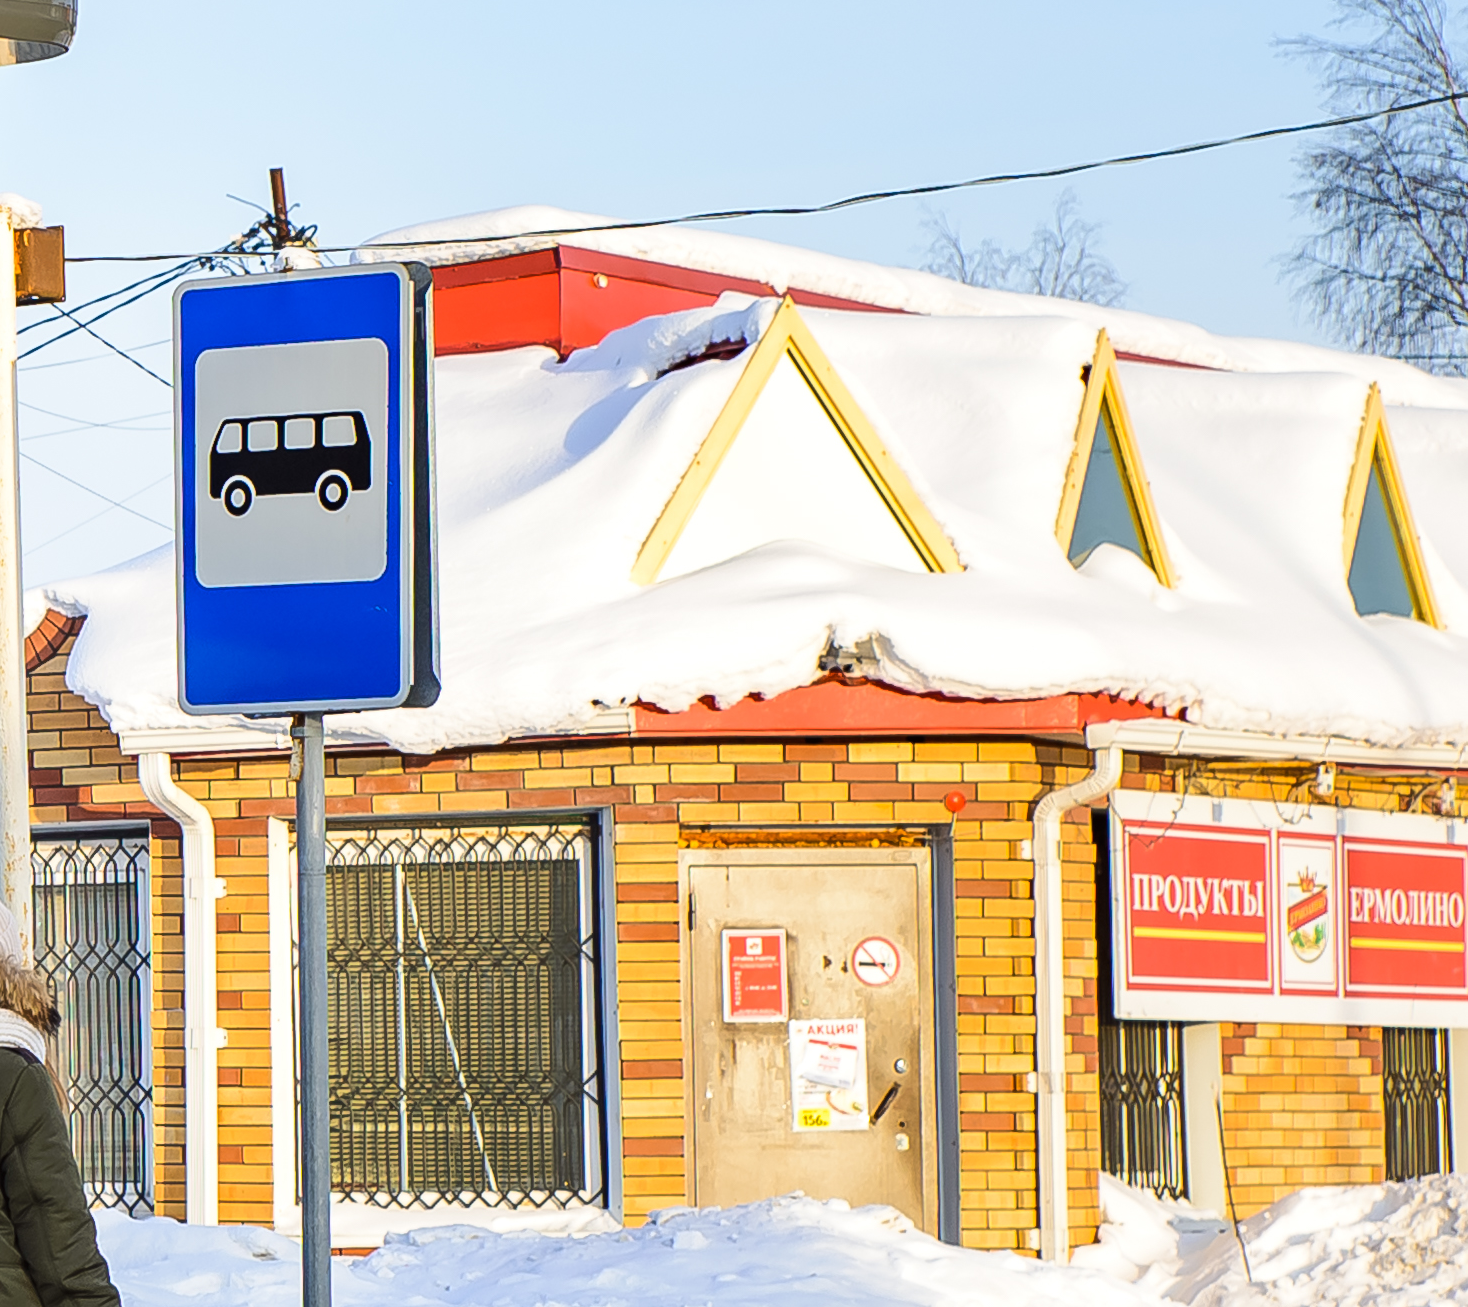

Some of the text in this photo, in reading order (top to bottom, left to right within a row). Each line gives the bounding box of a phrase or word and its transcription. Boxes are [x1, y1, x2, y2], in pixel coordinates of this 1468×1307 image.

[1132, 873, 1265, 922] ПРОДУКТЫ
[1349, 886, 1465, 929] ЕРМОЛИНО
[807, 1023, 858, 1036] АКЦИЯ!
